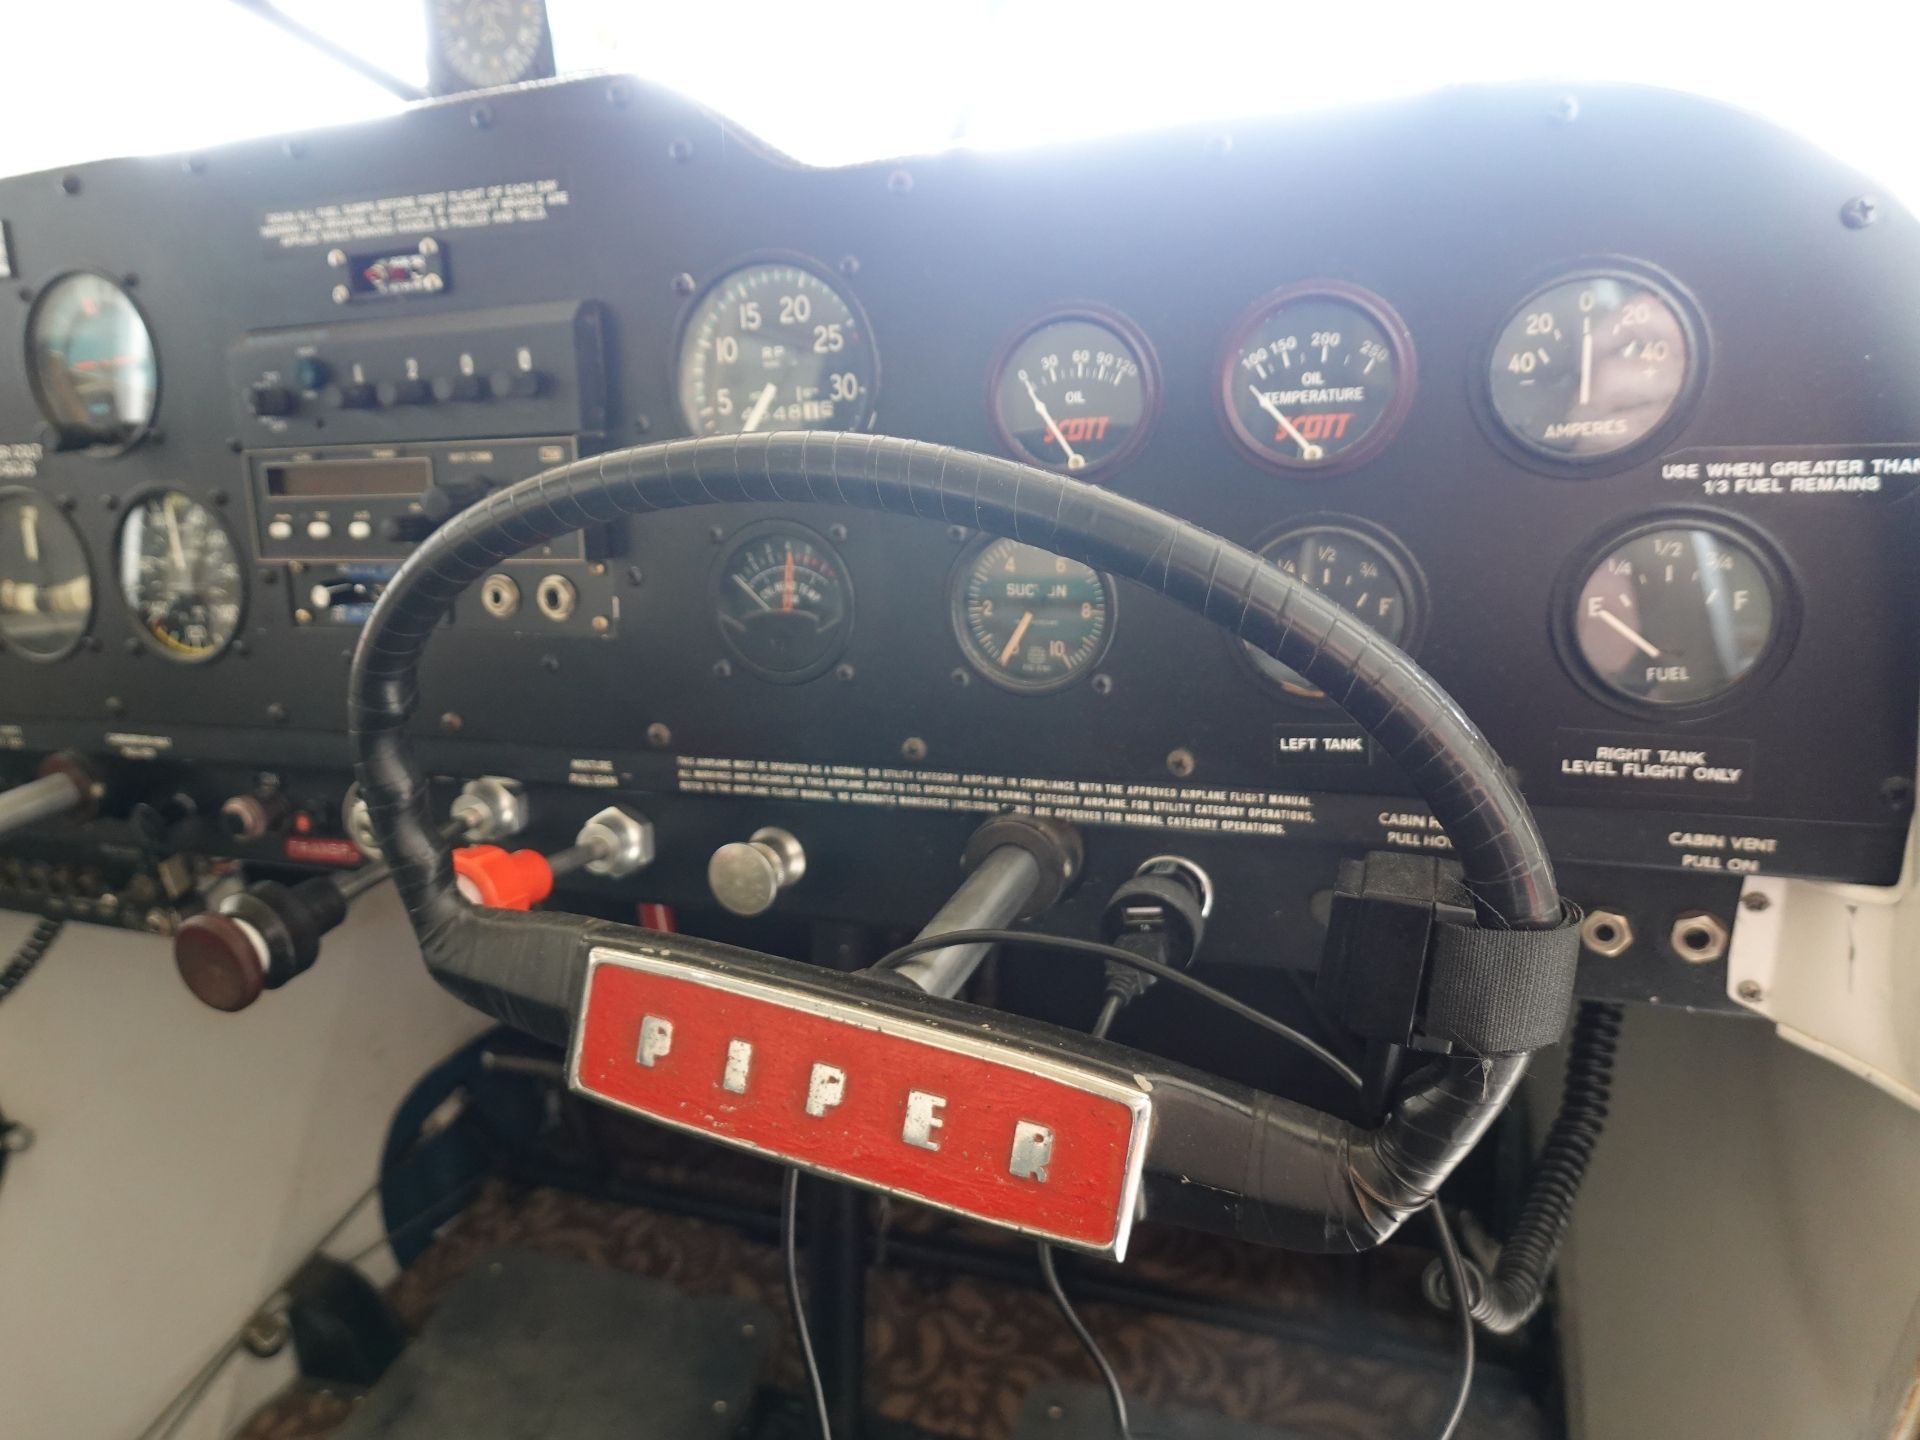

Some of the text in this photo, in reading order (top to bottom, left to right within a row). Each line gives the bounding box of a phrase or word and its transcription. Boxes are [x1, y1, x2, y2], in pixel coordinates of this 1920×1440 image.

[779, 294, 811, 325] 20
[1578, 290, 1594, 312] 0
[739, 302, 762, 331] 15
[1526, 312, 1554, 336] 20
[1621, 303, 1650, 326] 20
[814, 323, 844, 353] 25
[1270, 336, 1297, 355] 150
[1311, 332, 1340, 347] 200
[716, 336, 738, 364] 10
[1072, 349, 1090, 363] 60
[1096, 351, 1114, 367] 90
[1241, 347, 1268, 371] 100
[1360, 340, 1389, 362] 250
[1640, 340, 1667, 362] 40
[1041, 354, 1058, 370] 30
[1115, 357, 1138, 377] 120
[1508, 351, 1536, 374] 40
[830, 372, 858, 401] 30
[1301, 371, 1325, 386] OIL
[717, 388, 733, 416] 5
[1065, 390, 1086, 405] OIL
[1262, 386, 1365, 406] TEMPERATURE
[1043, 415, 1111, 445] SCOTT
[1274, 412, 1357, 443] SCOTT
[1544, 418, 1628, 439] AMPERES
[1662, 458, 1920, 480] USE WHEN GREATER THAN
[1702, 476, 1881, 495] 1/3 FUEL REMAINS
[1319, 545, 1336, 562] 1/2
[1654, 539, 1683, 557] 1/2
[1005, 556, 1016, 572] 4
[1360, 562, 1377, 577] 3/4
[1608, 559, 1632, 575] 1/4
[1705, 552, 1734, 570] 3/4
[1006, 583, 1068, 598] SUCN
[982, 600, 993, 617] 2
[1080, 602, 1092, 619] 8
[1379, 597, 1393, 616] F
[1588, 597, 1603, 617] E
[1733, 591, 1749, 611] F
[1050, 640, 1065, 657] 10
[1646, 666, 1689, 682] FUEL
[1279, 737, 1363, 751] LEFT TANK
[1596, 746, 1707, 766] RIGHT TANK
[1561, 759, 1743, 784] LEVEL FLIGHT ONLY
[1019, 777, 1076, 791] COMPLIANCE
[1079, 781, 1103, 793] WITH
[1105, 783, 1124, 794] THE
[1127, 784, 1177, 797] APPROVED
[1180, 787, 1227, 800] AIRPLANE
[1230, 791, 1264, 803] FLIGHT
[1268, 793, 1315, 806] MANUAL.
[1035, 793, 1081, 806] CATEGORY
[1131, 800, 1150, 811] FOR
[1153, 801, 1191, 814] UTILITY
[1194, 804, 1245, 818] CATEGORY
[1034, 807, 1051, 819] ARE
[1055, 808, 1102, 822] APPROVED
[1104, 812, 1122, 824] FOR
[1125, 813, 1163, 827] NORMAL
[1167, 816, 1218, 831] CATEGORY
[1221, 820, 1286, 836] OPERATIONS.
[1378, 812, 1426, 828] CABIN
[1387, 831, 1420, 846] PULL
[1668, 831, 1778, 852] CABIN VENT
[1681, 854, 1760, 873] PULL ON
[635, 1013, 1054, 1184] PIPER
